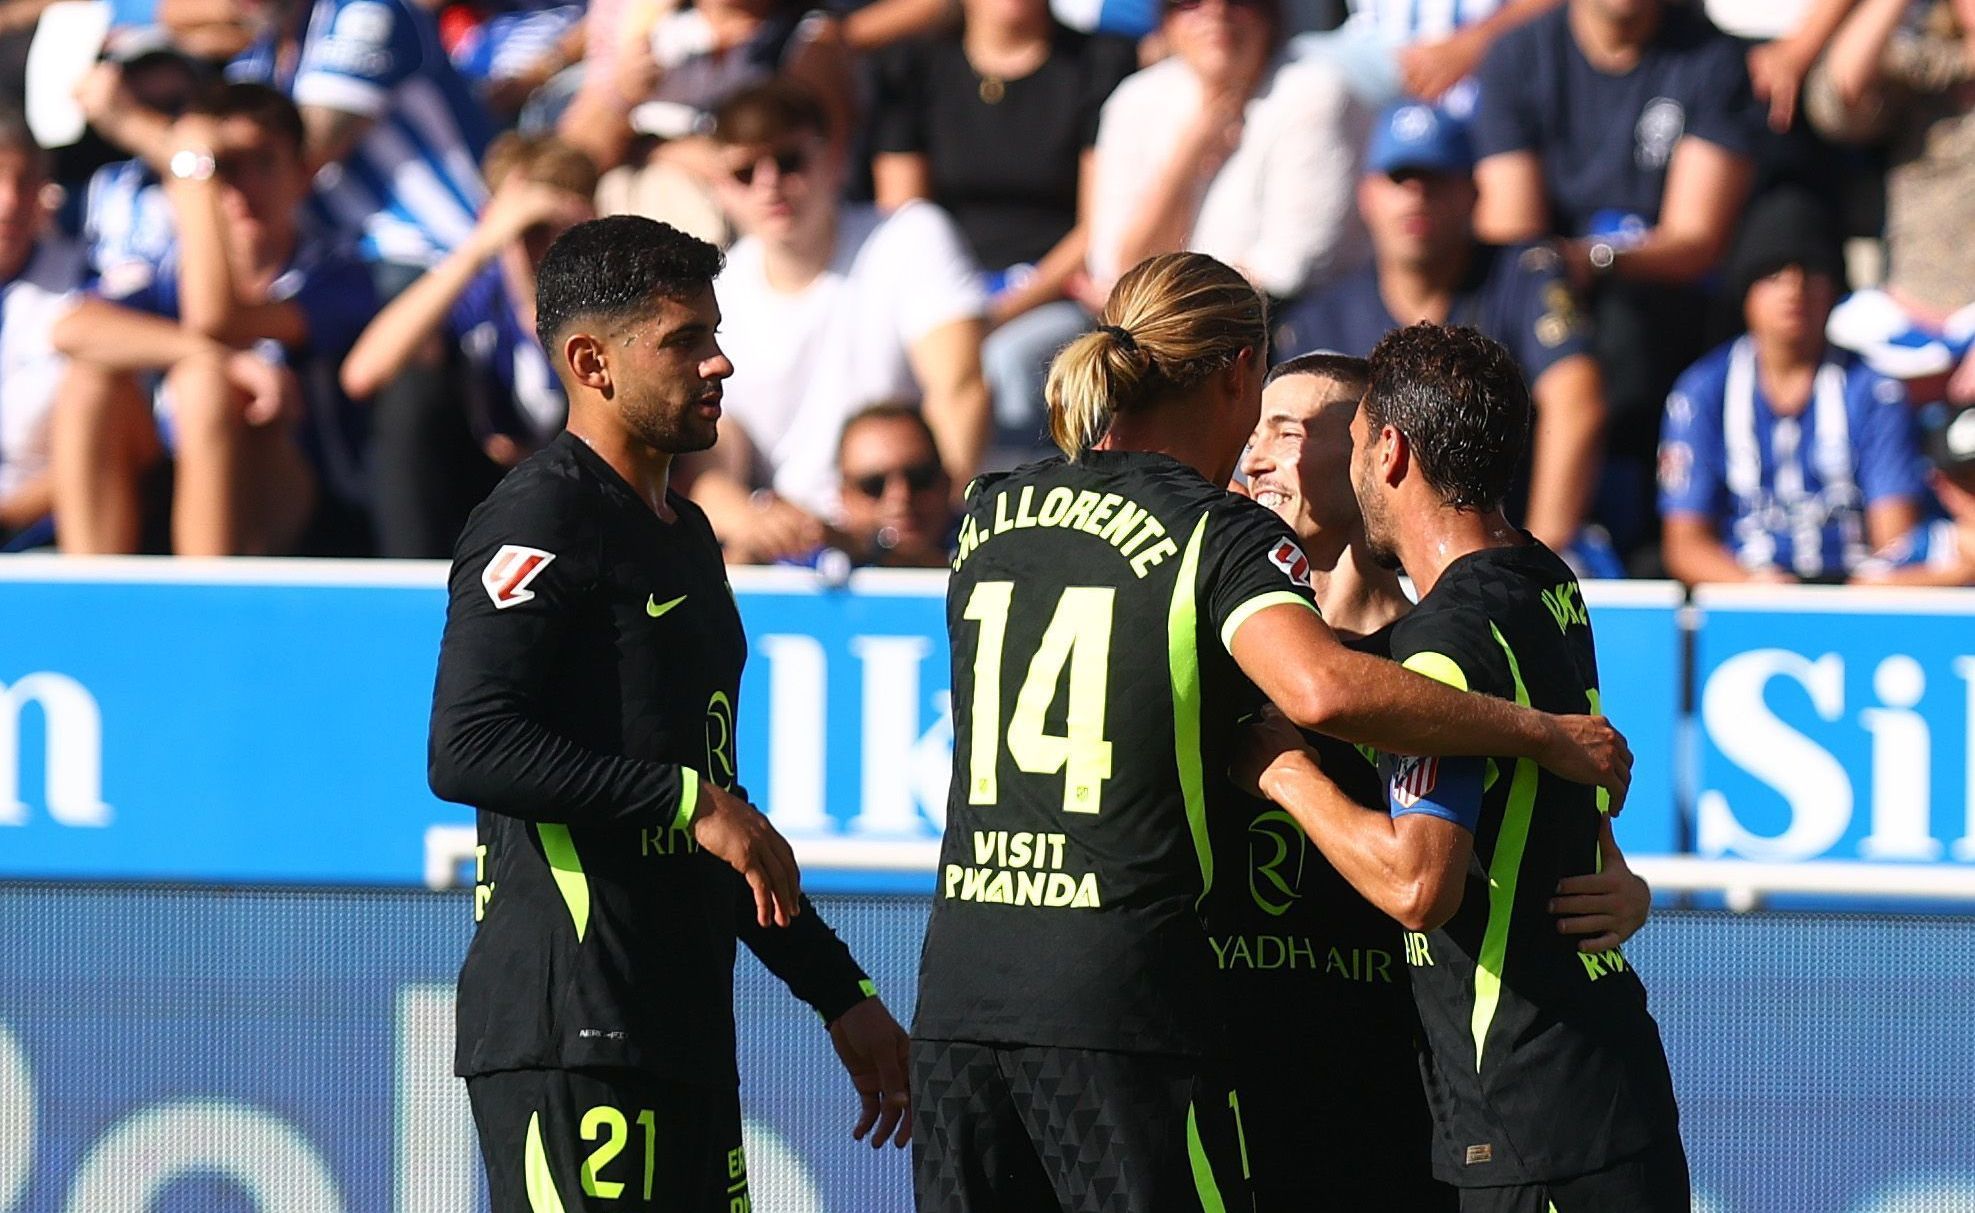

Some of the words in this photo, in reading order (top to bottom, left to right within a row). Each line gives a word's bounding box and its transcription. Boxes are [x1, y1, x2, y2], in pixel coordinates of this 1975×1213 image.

[993, 485, 1178, 580] LLORENTE
[963, 580, 1117, 815] 14
[973, 830, 1066, 869] VISIT
[1325, 946, 1393, 983] AIR
[580, 1105, 656, 1201] 21
